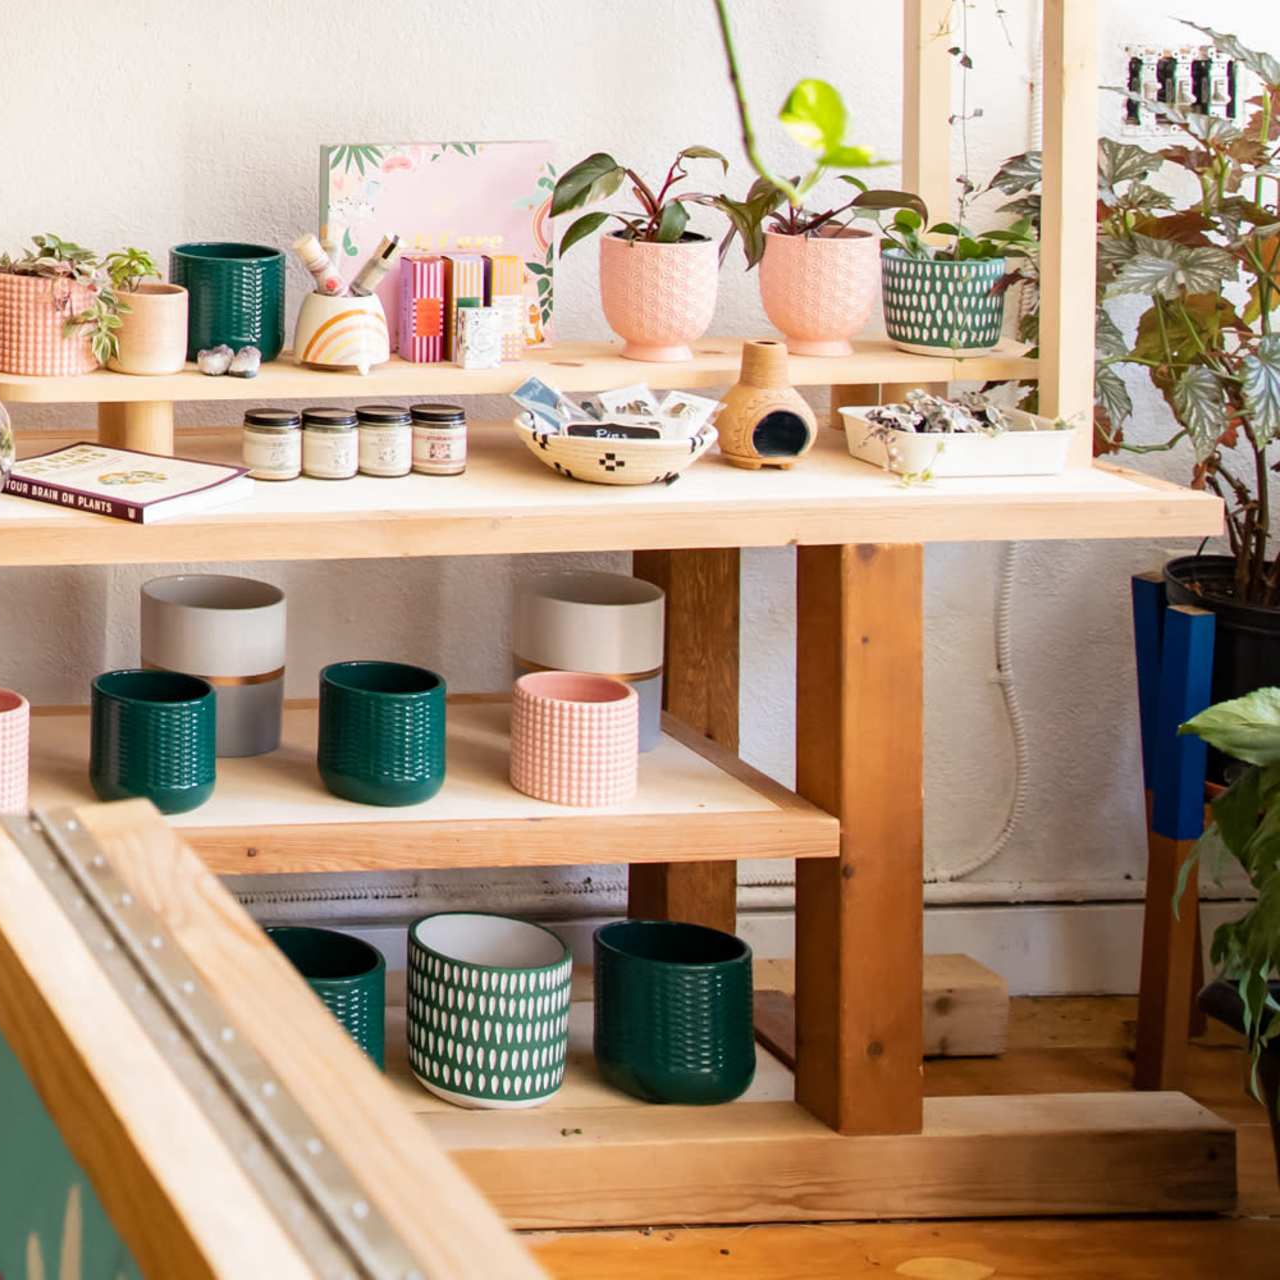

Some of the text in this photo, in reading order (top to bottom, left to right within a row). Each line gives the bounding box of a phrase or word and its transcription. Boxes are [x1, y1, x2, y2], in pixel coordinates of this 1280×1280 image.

[5, 479, 29, 495] YOUR
[31, 485, 59, 503] BRAIN
[61, 492, 75, 504] ON
[77, 496, 113, 514] PLANTS
